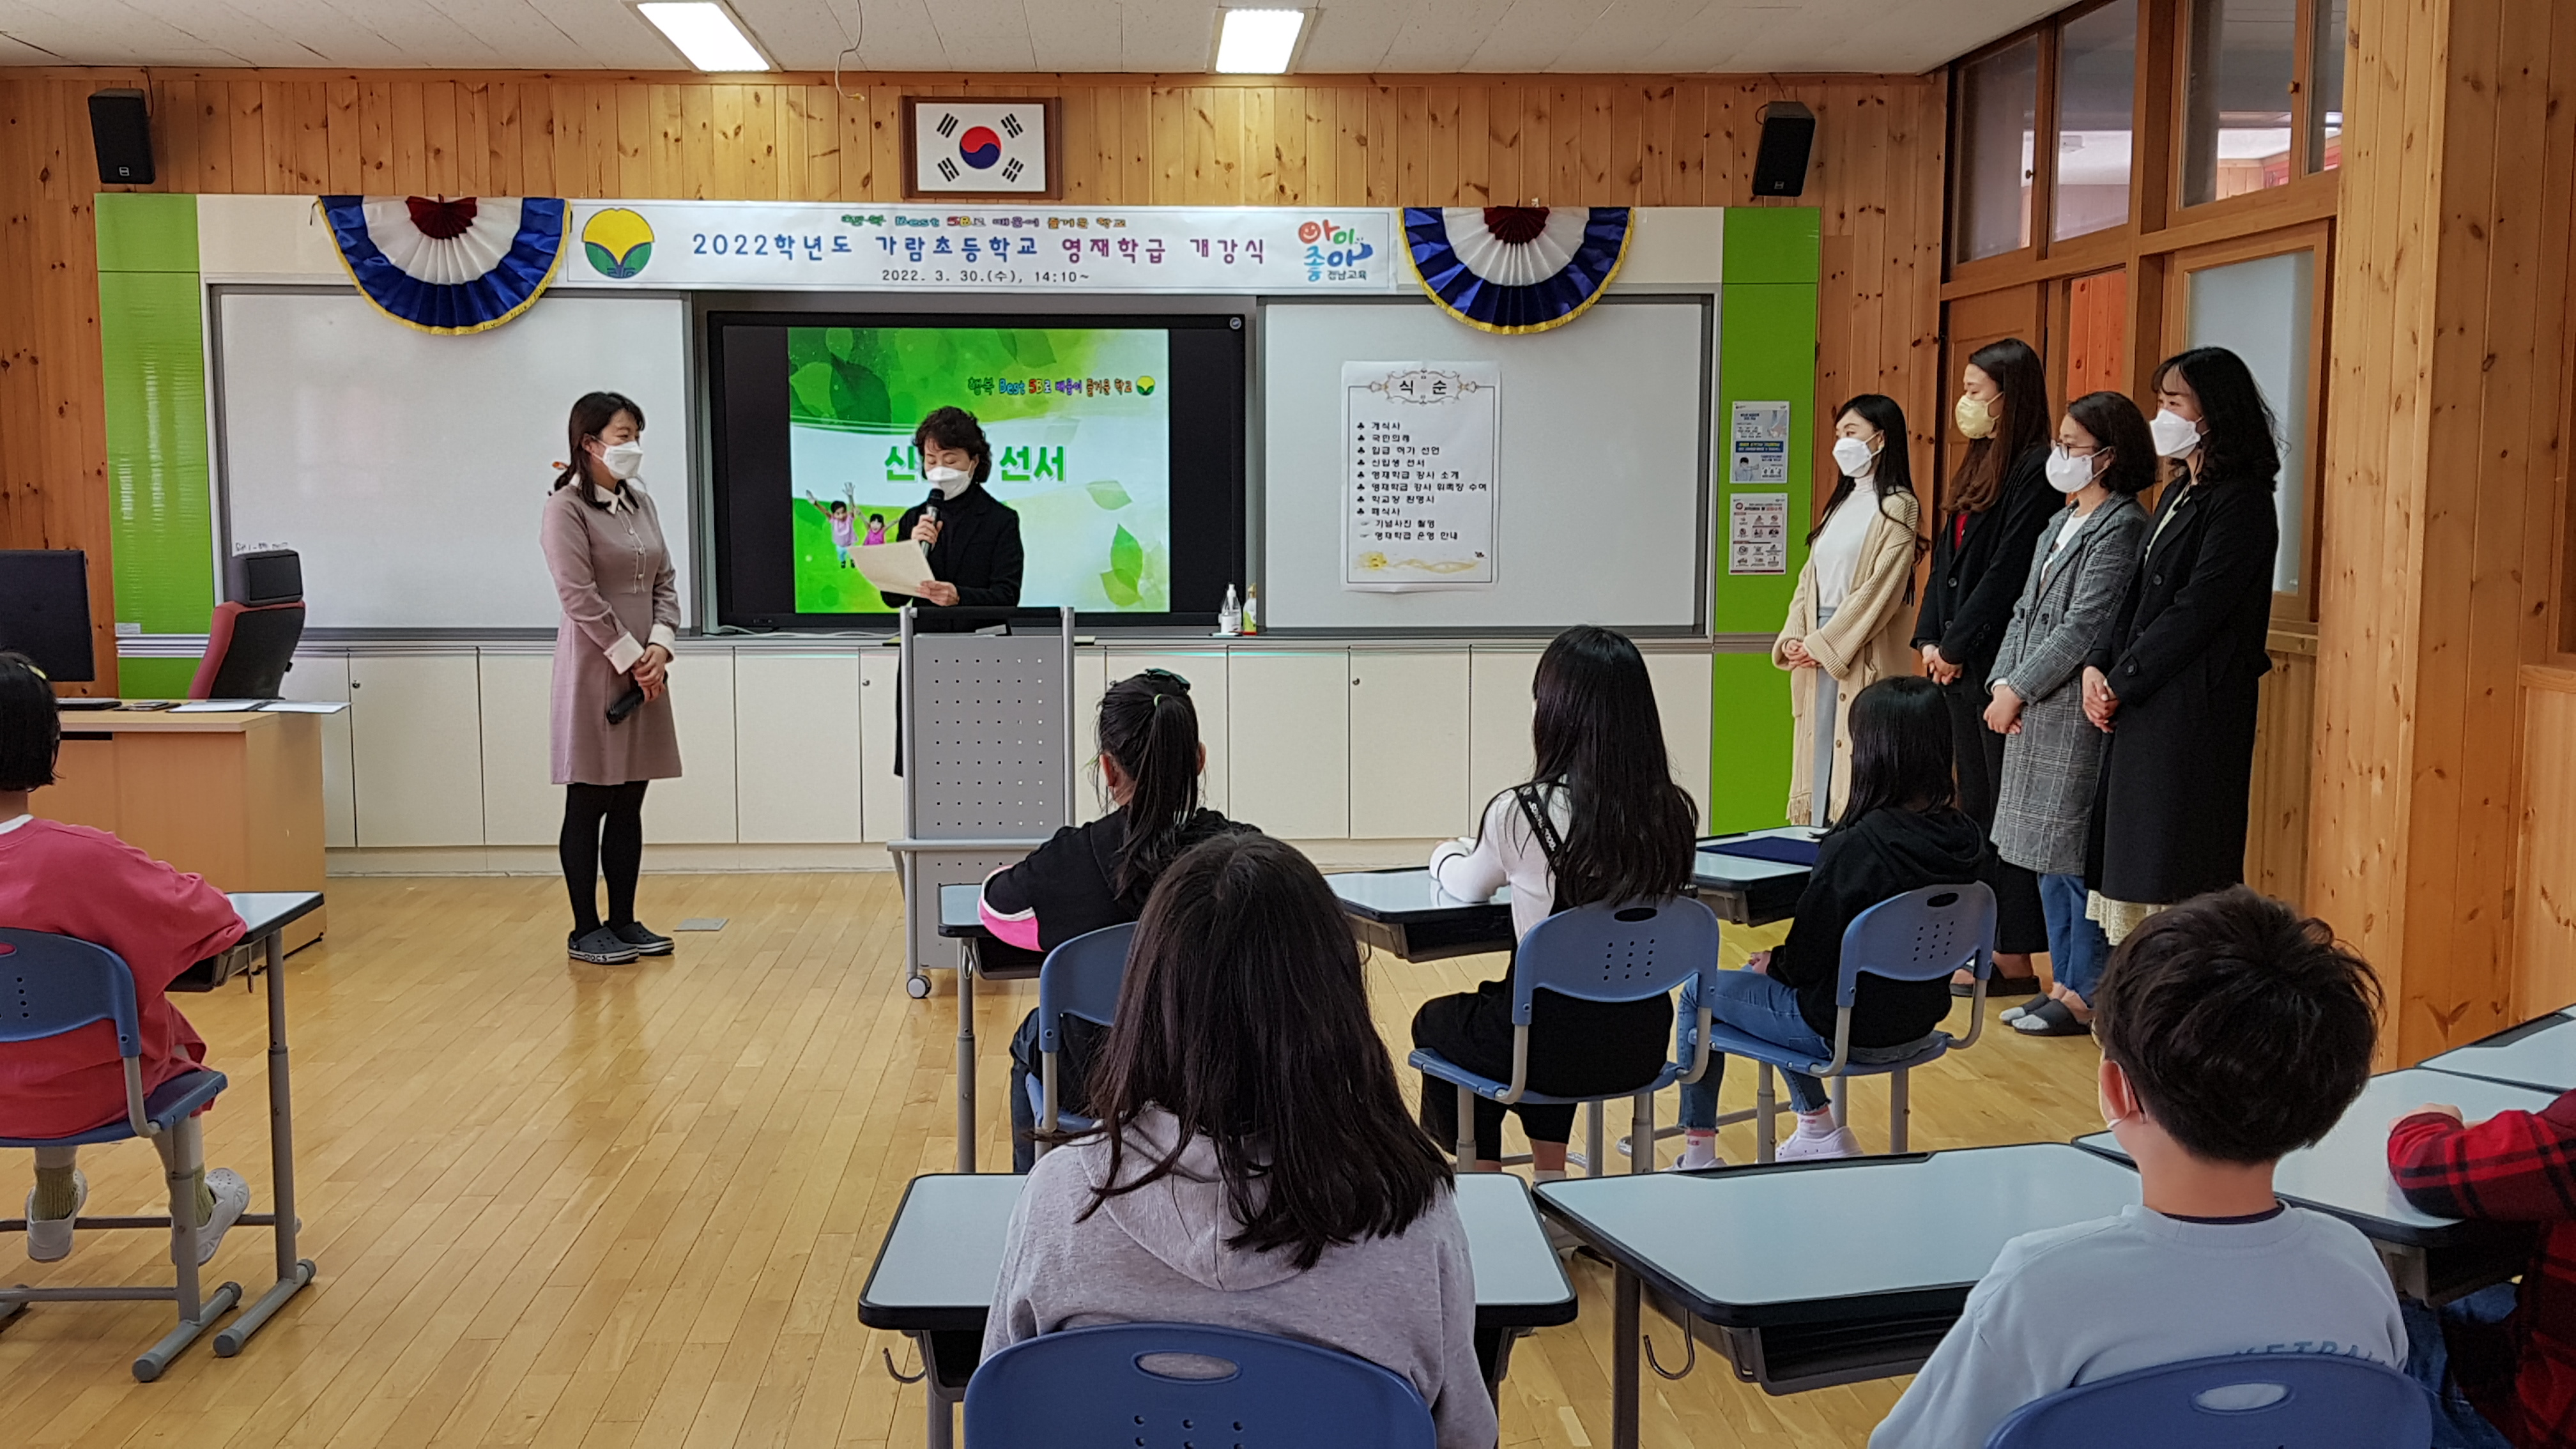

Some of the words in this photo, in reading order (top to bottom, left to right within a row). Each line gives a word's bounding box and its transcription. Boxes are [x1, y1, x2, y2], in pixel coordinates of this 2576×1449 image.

[1096, 217, 1126, 229] 학교
[693, 234, 852, 260] 2022학년도
[875, 236, 1038, 263] 가람초등학교
[1062, 238, 1166, 264] 영재학급
[1190, 239, 1264, 264] 개강식
[1304, 242, 1373, 282] 좋아
[882, 270, 926, 282] 2022.
[935, 270, 950, 282] 3.
[1034, 272, 1090, 283] 14:10~
[1328, 270, 1367, 280] 전남교육
[968, 377, 995, 395] 행복
[999, 378, 1025, 395] Best
[1029, 378, 1052, 394] 5B로
[1055, 378, 1082, 395] 배움이
[1086, 378, 1110, 397] 즐거운
[1114, 378, 1132, 395] 학교
[1400, 380, 1413, 395] 식
[1432, 380, 1447, 395] 순
[1372, 422, 1400, 431] 개식사
[1372, 434, 1409, 443] 국민의례
[1422, 447, 1439, 455] 선언
[999, 446, 1064, 481] 선서
[1372, 471, 1409, 480] 영재학급
[1416, 471, 1434, 479] 강사
[1441, 471, 1459, 479] 소개
[1372, 483, 1408, 491] 영재학급
[1414, 483, 1432, 491] 강사
[1469, 483, 1487, 491] 수여
[1375, 532, 1411, 540] 영재학급
[1417, 532, 1434, 540] 운영
[1441, 532, 1458, 540] 안내
